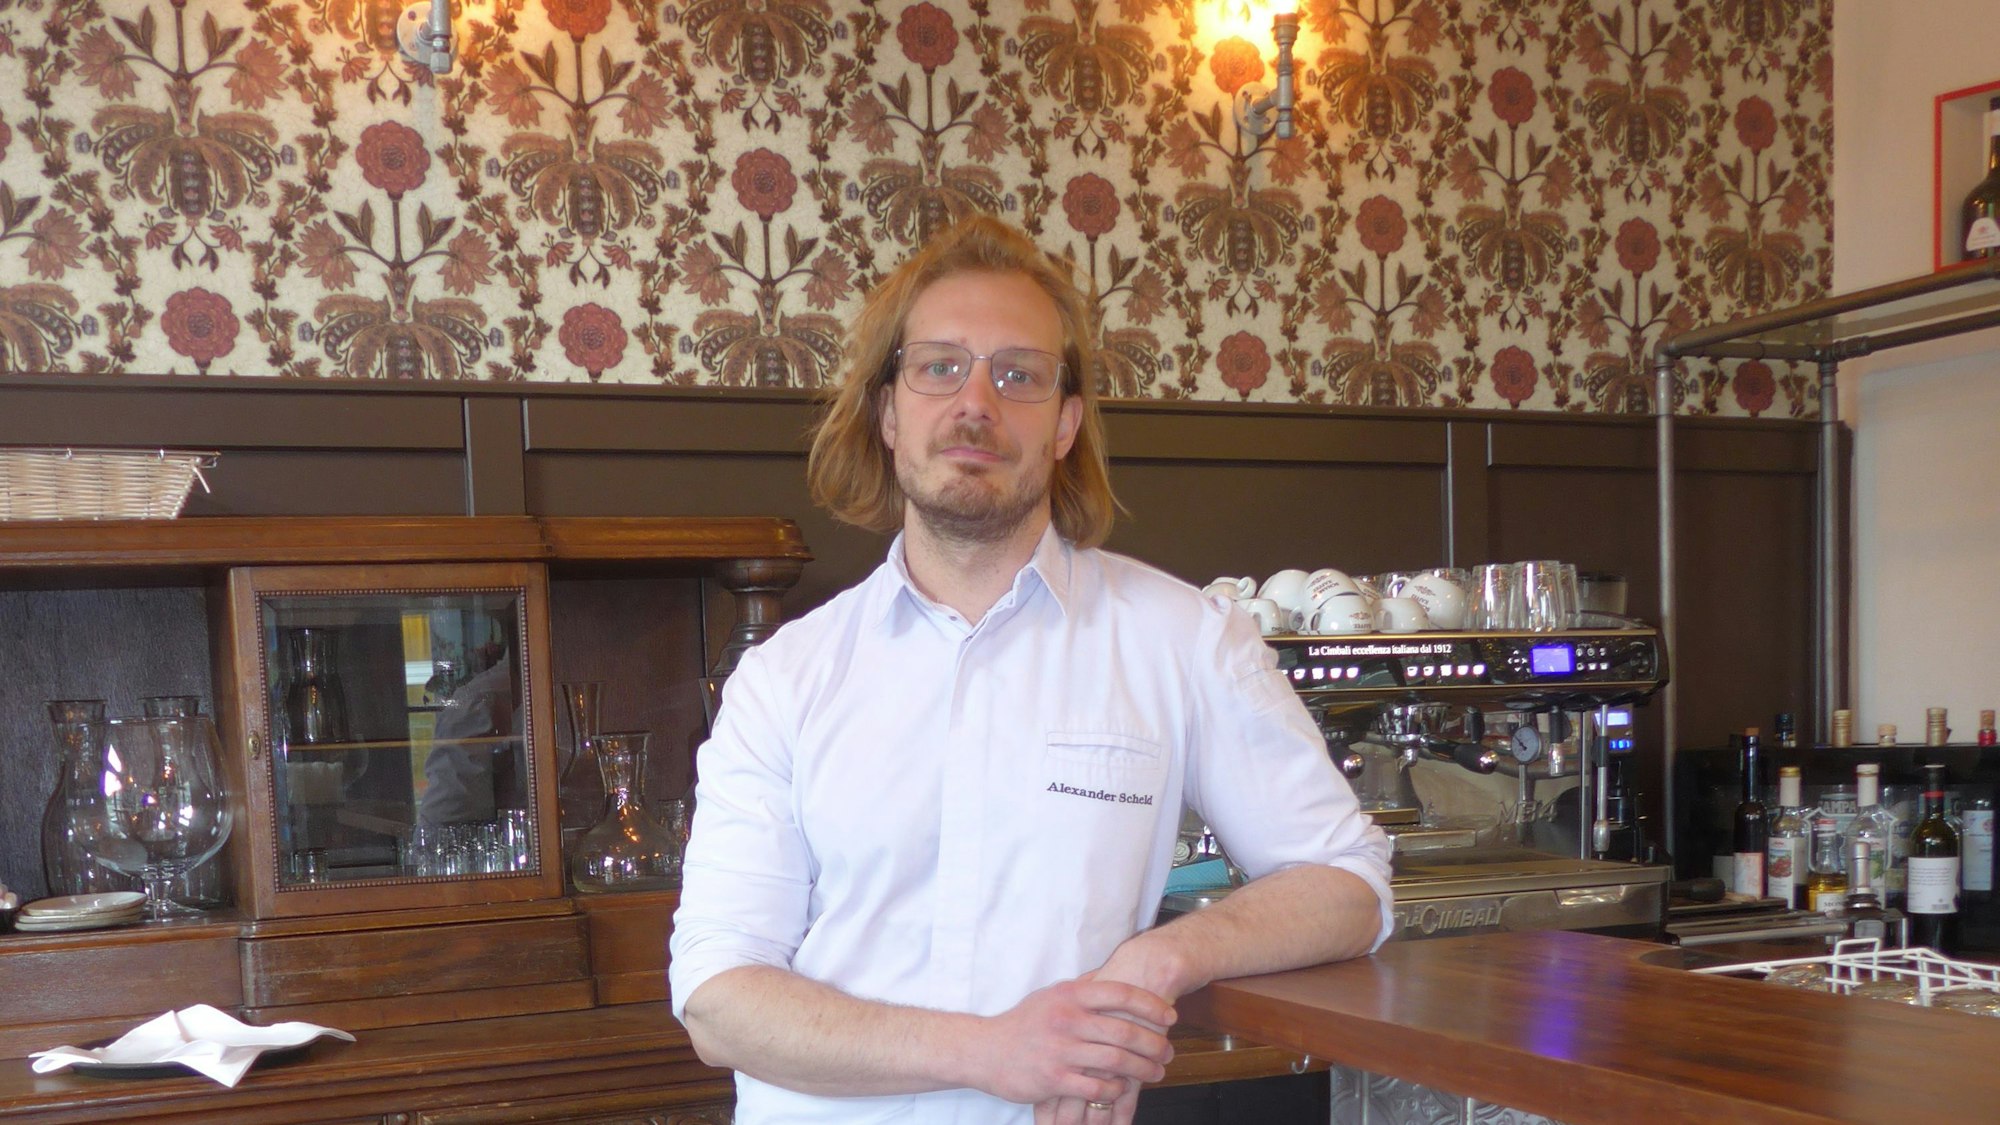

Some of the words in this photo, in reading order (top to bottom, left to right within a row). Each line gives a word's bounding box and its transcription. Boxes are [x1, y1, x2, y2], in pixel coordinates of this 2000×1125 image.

[1308, 646, 1320, 656] La
[1320, 645, 1351, 656] Cimbali
[1352, 644, 1391, 655] eccellenza
[1392, 644, 1419, 654] italiana
[1420, 644, 1432, 654] dal
[1433, 644, 1452, 654] 1912
[1047, 782, 1117, 802] Alexander
